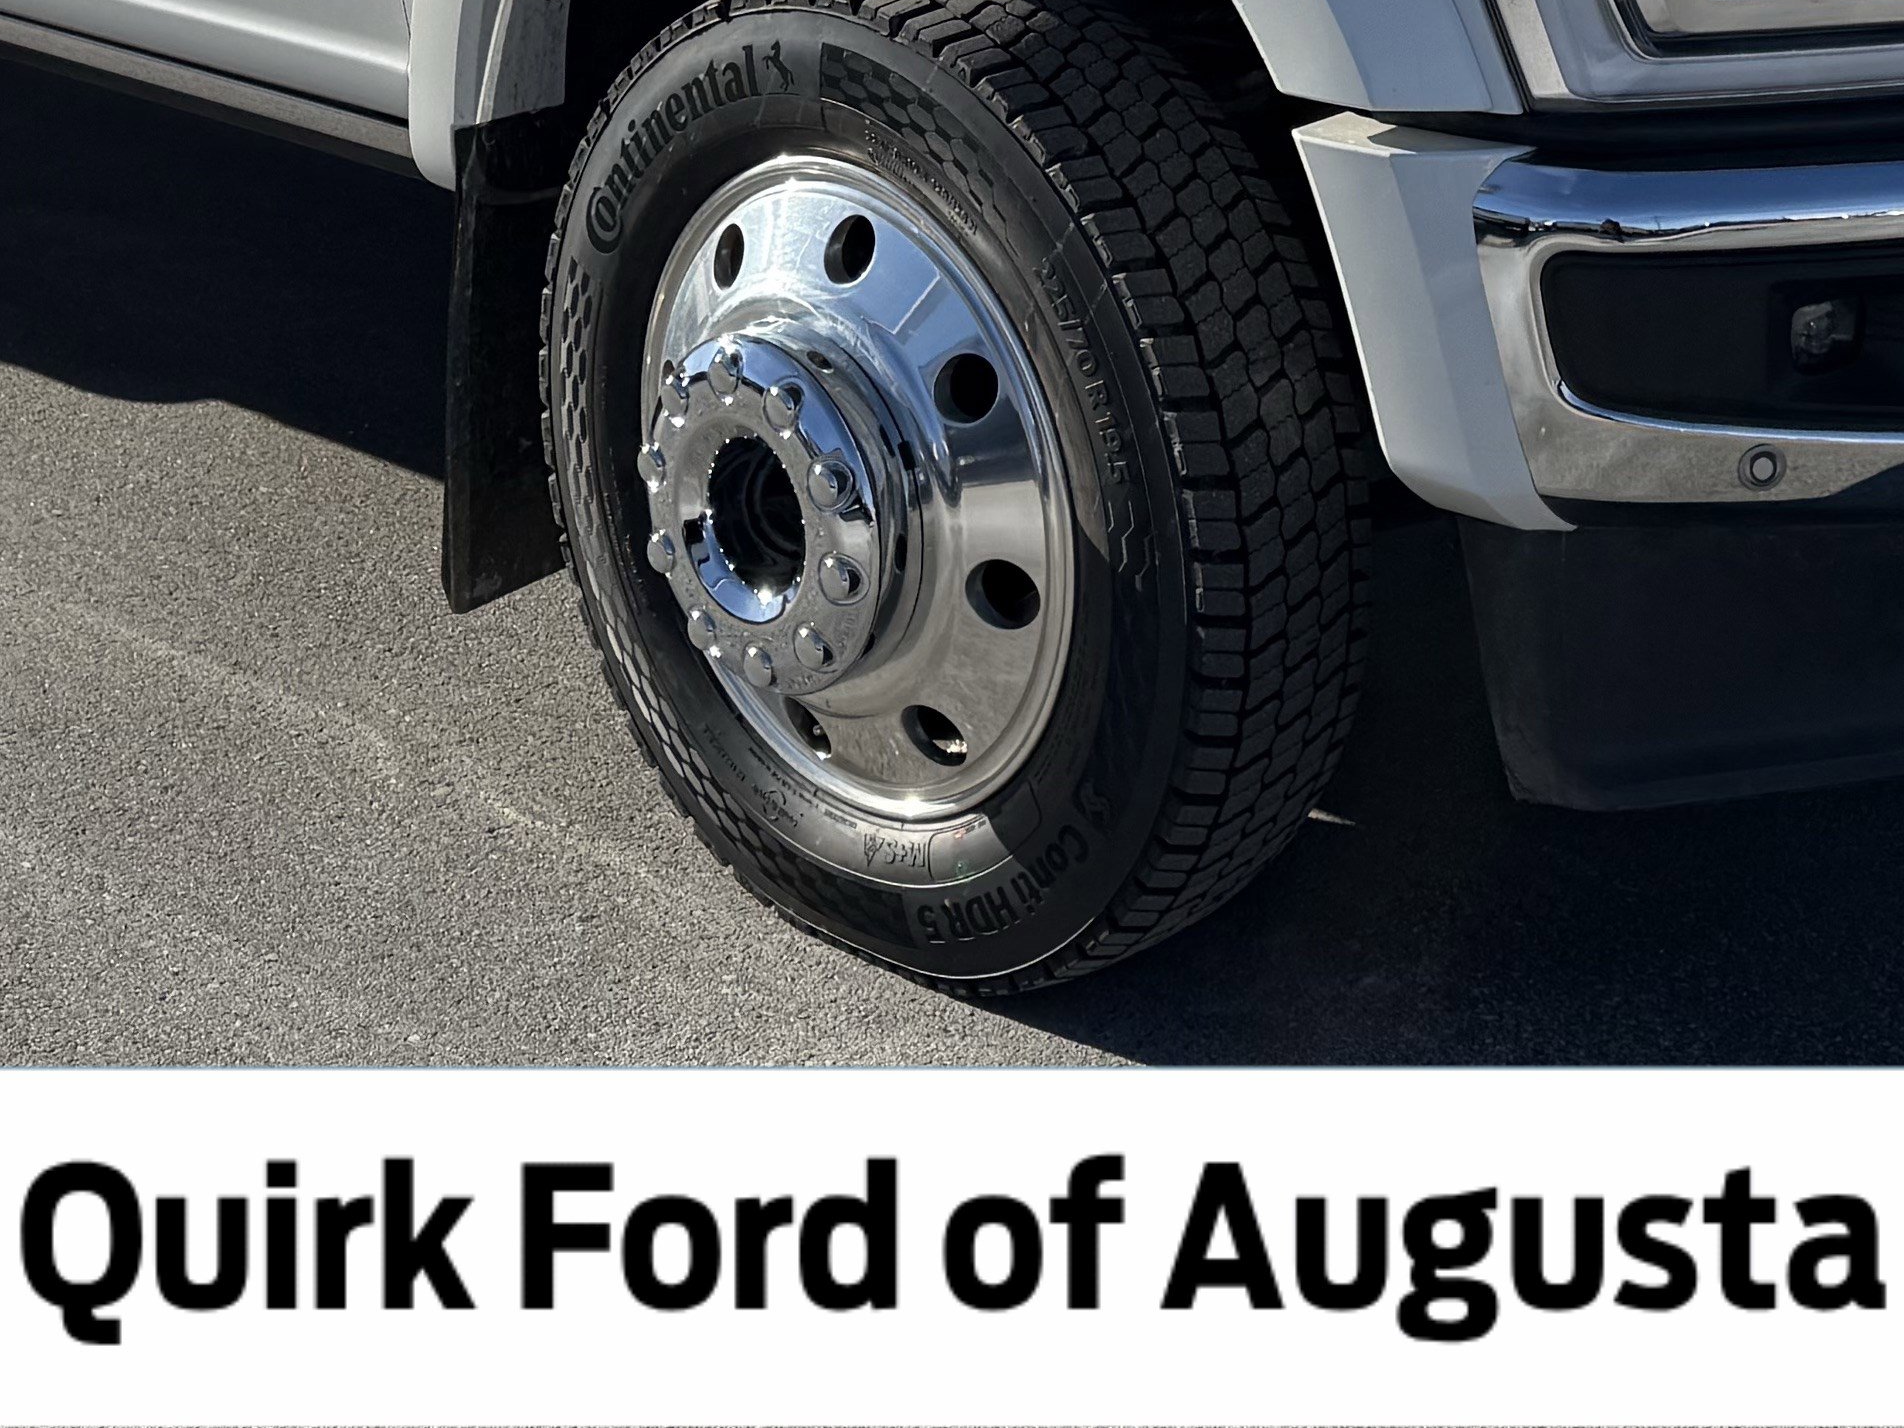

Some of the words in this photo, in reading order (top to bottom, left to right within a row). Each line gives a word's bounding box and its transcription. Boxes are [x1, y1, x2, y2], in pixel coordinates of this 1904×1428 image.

[586, 44, 759, 254] Continental
[941, 886, 1022, 941] HDR
[1010, 824, 1089, 916] Conti
